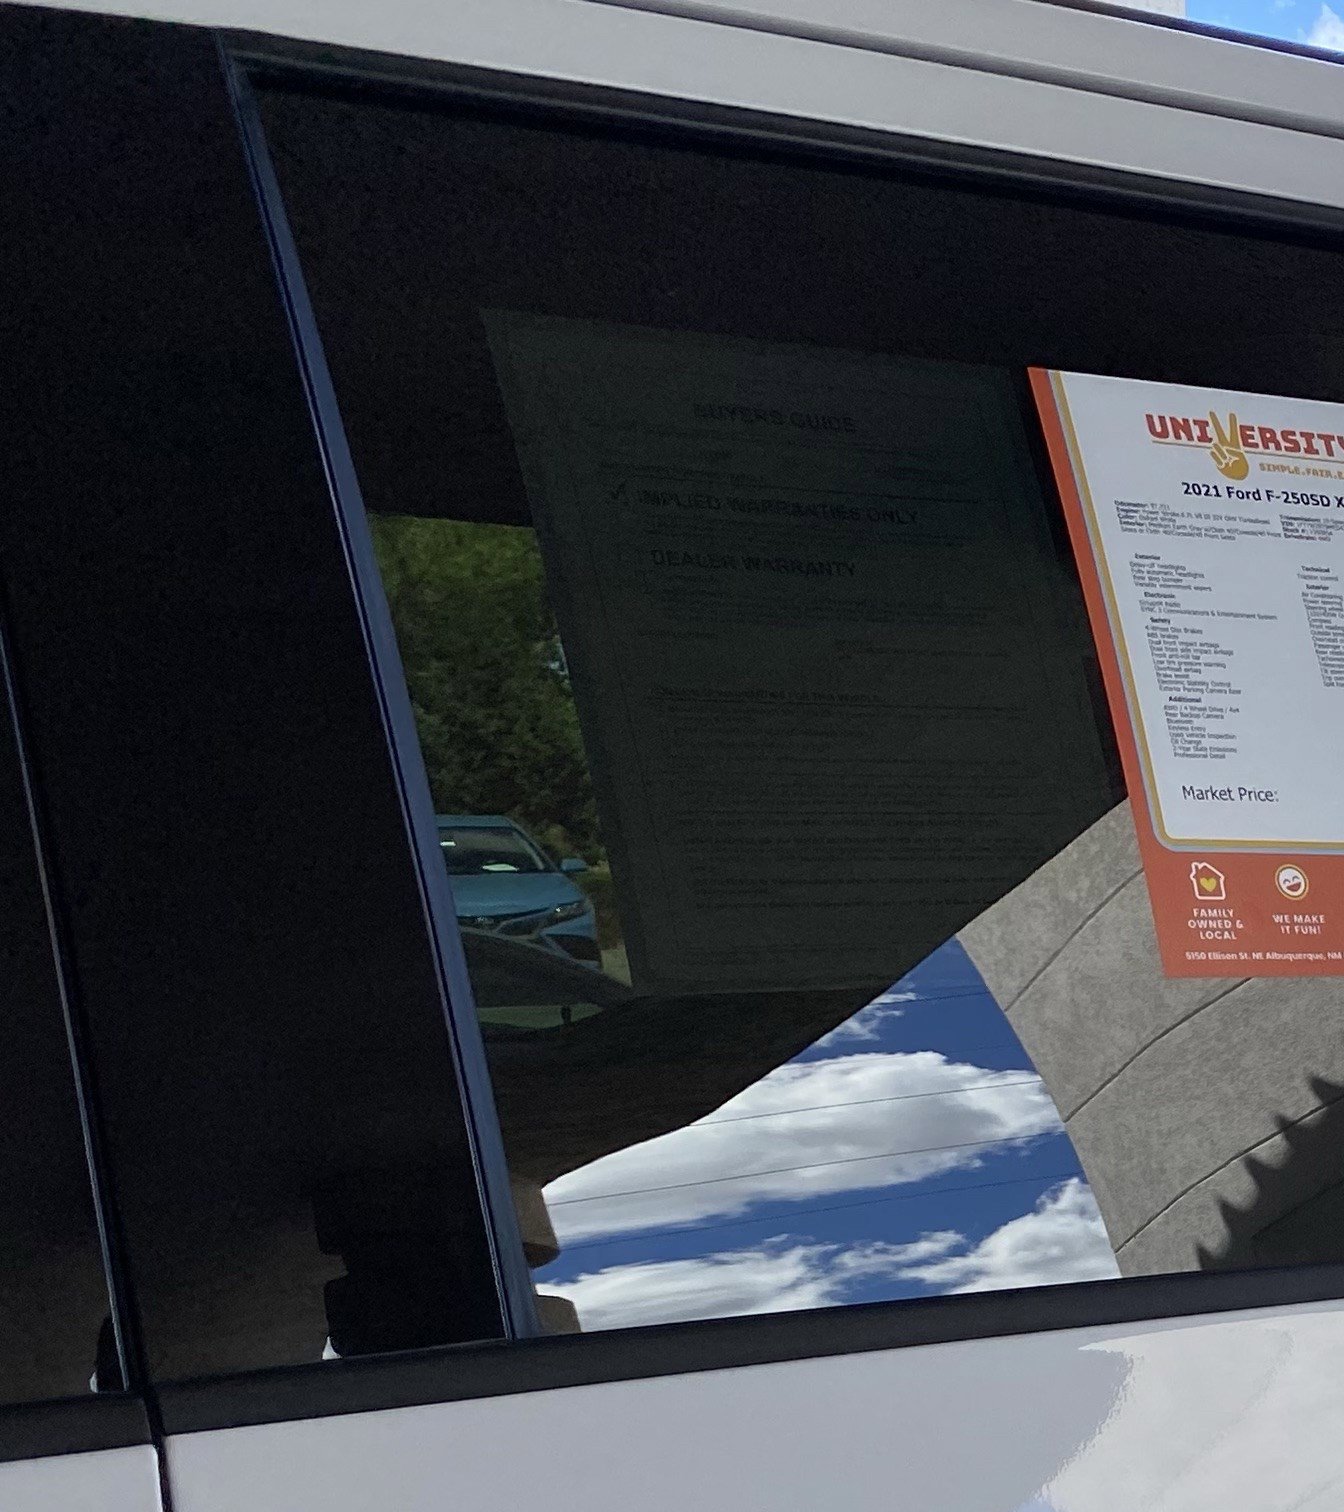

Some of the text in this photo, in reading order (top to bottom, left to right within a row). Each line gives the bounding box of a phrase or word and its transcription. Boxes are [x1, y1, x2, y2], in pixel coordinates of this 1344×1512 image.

[791, 410, 857, 433] GUIDE
[1181, 481, 1222, 498] 2021
[1226, 485, 1262, 501] Ford
[1266, 490, 1330, 507] F-250SD
[867, 505, 919, 526] ONLY
[742, 554, 856, 579] WARRANTY
[1181, 785, 1279, 803] Market Price:
[1193, 908, 1234, 919] FAMILY
[1272, 914, 1326, 924] WE MAKE
[1187, 919, 1244, 929] OWNED &
[1200, 930, 1238, 940] LOCAL
[1281, 925, 1321, 935] IT FUN!
[1327, 952, 1342, 961] NM
